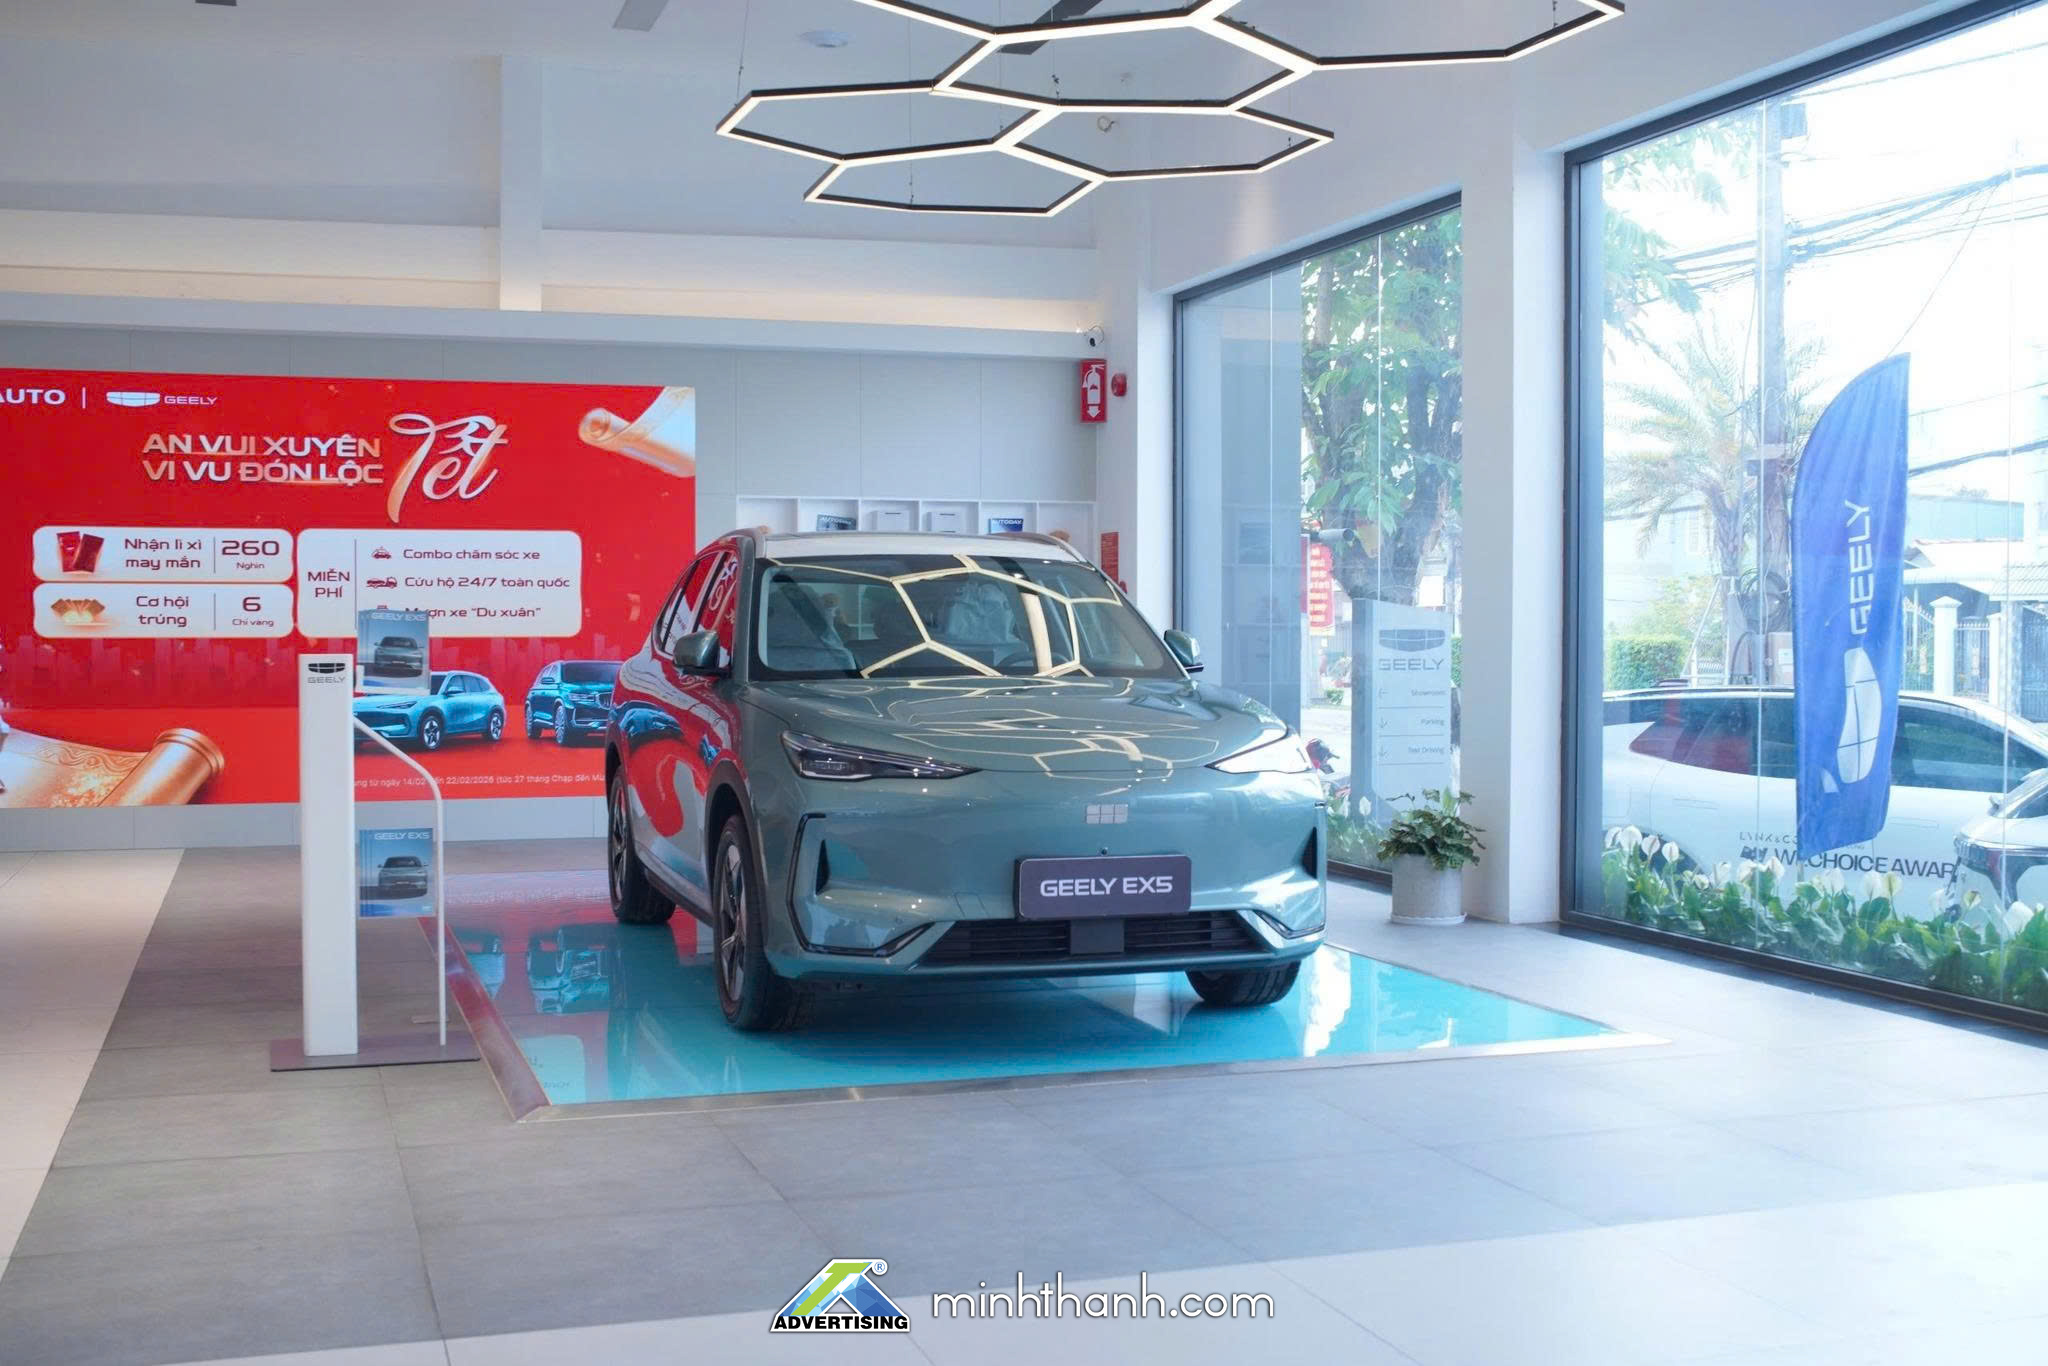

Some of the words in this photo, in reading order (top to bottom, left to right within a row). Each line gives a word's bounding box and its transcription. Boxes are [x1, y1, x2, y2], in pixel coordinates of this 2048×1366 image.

[164, 395, 218, 405] GEELY
[142, 433, 192, 454] AN
[200, 435, 255, 456] VUI
[263, 433, 381, 458] XUYÊN
[142, 460, 175, 481] VI
[183, 461, 232, 482] VU
[239, 458, 311, 482] ĐÓN
[320, 459, 384, 486] LỘC
[387, 413, 509, 523] Tết
[124, 538, 170, 552] Nhận
[221, 540, 280, 556] 260
[403, 549, 453, 559] Combo
[455, 549, 492, 559] chăm
[494, 549, 519, 559] sóc
[522, 551, 541, 559] xe
[125, 558, 161, 570] may
[166, 556, 201, 568] mắn
[1844, 499, 1874, 636] GEELY
[307, 568, 350, 582] MIỄN
[404, 577, 433, 587] Cứu
[437, 577, 455, 588] hộ
[458, 577, 497, 587] 24/7
[501, 577, 533, 587] toàn
[537, 577, 570, 589] quốc
[315, 586, 343, 598] PHÍ
[136, 595, 159, 607] Cơ
[164, 596, 189, 609] hội
[242, 596, 262, 612] 6
[450, 609, 468, 617] xe
[138, 614, 187, 627] trúng
[1379, 658, 1445, 671] GEELY
[307, 676, 346, 684] GEELY
[374, 832, 407, 841] GEELY
[408, 831, 430, 840] EX5
[1040, 878, 1118, 897] GEELY
[1122, 876, 1173, 895] EX5
